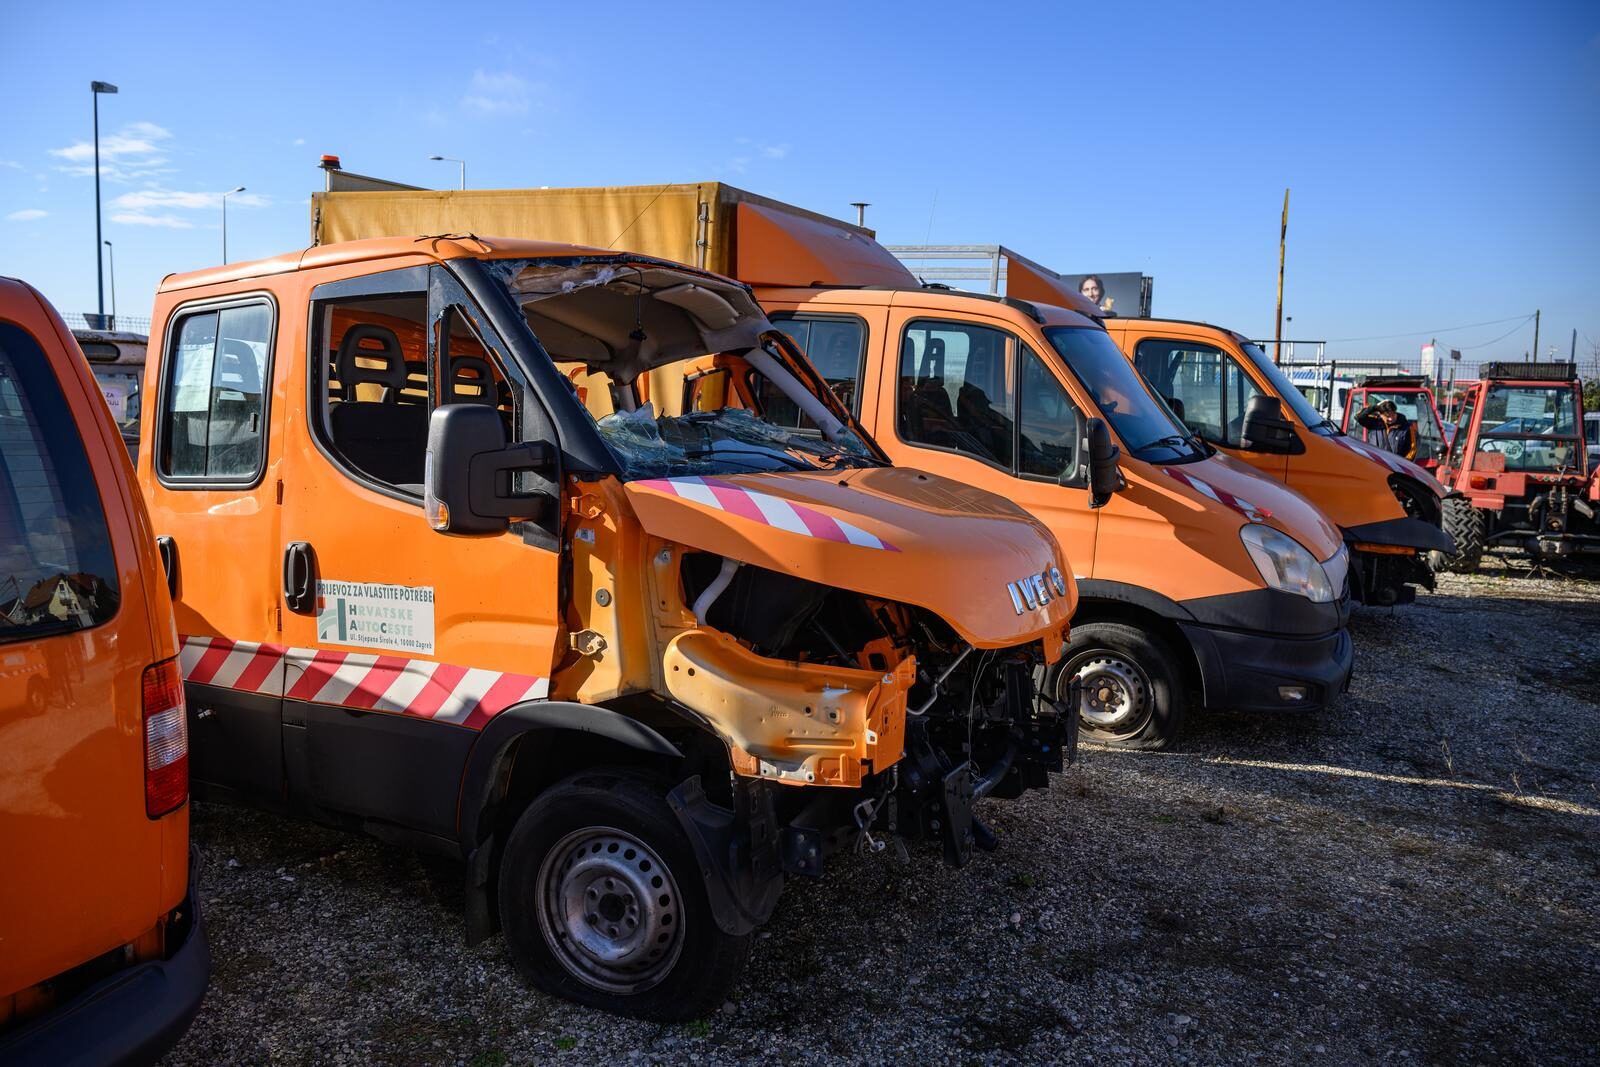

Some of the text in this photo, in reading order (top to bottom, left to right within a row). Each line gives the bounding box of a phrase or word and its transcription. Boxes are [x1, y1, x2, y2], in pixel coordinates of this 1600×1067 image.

[317, 583, 432, 602] PRIJEVOZ ZA VLASTITE POTREBE
[350, 604, 413, 620] HRVATSKE
[400, 638, 414, 647] 10000
[415, 640, 432, 650] Zagreb
